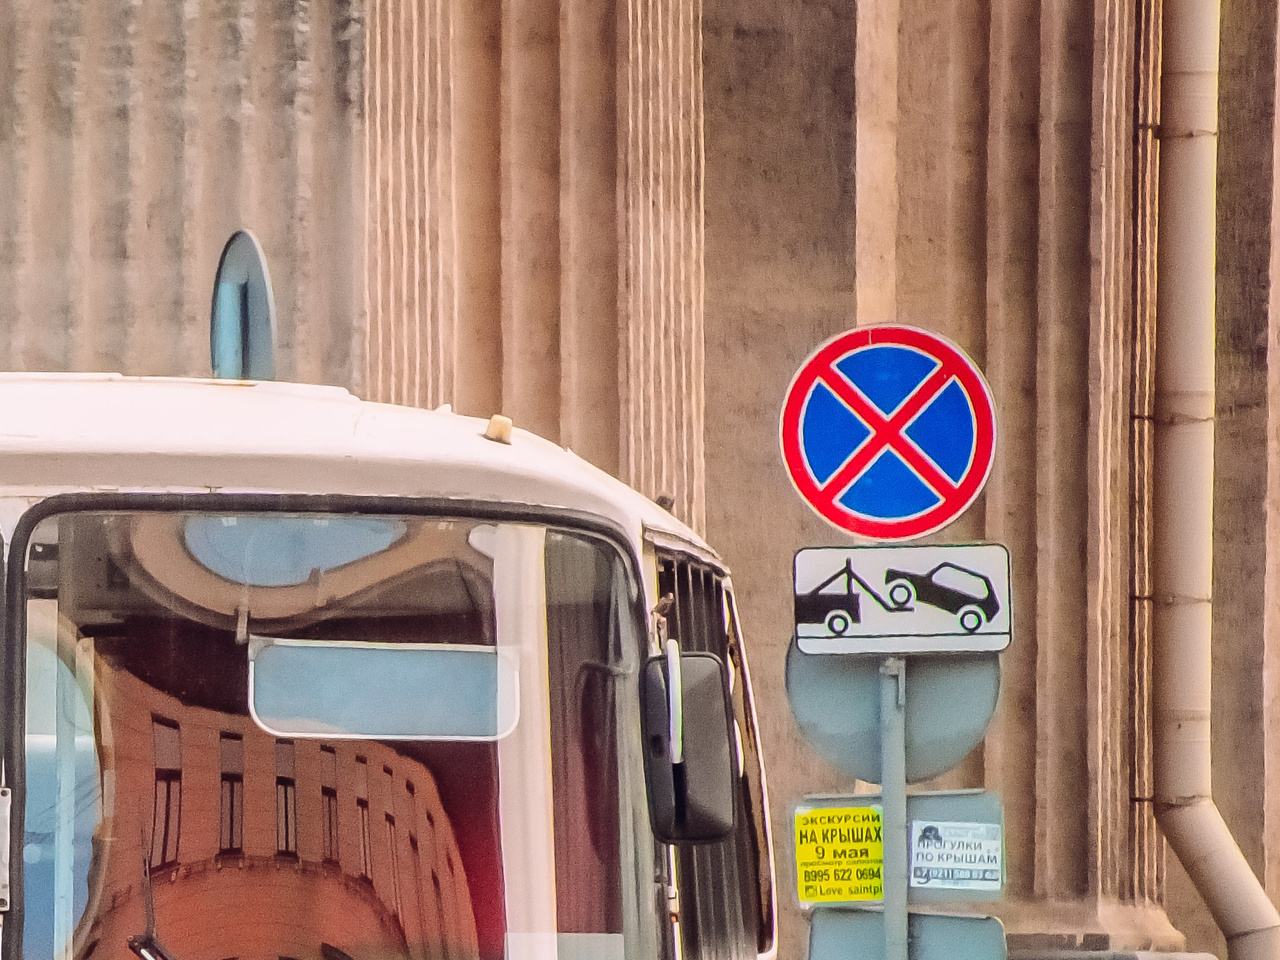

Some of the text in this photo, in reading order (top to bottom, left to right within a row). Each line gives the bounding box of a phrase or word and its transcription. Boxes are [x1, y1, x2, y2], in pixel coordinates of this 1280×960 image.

[802, 813, 881, 826] ЭКСКУРСИИ
[799, 826, 882, 845] НА КРЫШАХ
[917, 840, 983, 851] ПРОГУЛКИ
[815, 845, 870, 860] 9 мая
[915, 852, 998, 864] ПО КРЫШАМ
[803, 866, 881, 883] 8995 622 0694
[819, 885, 843, 896] Love
